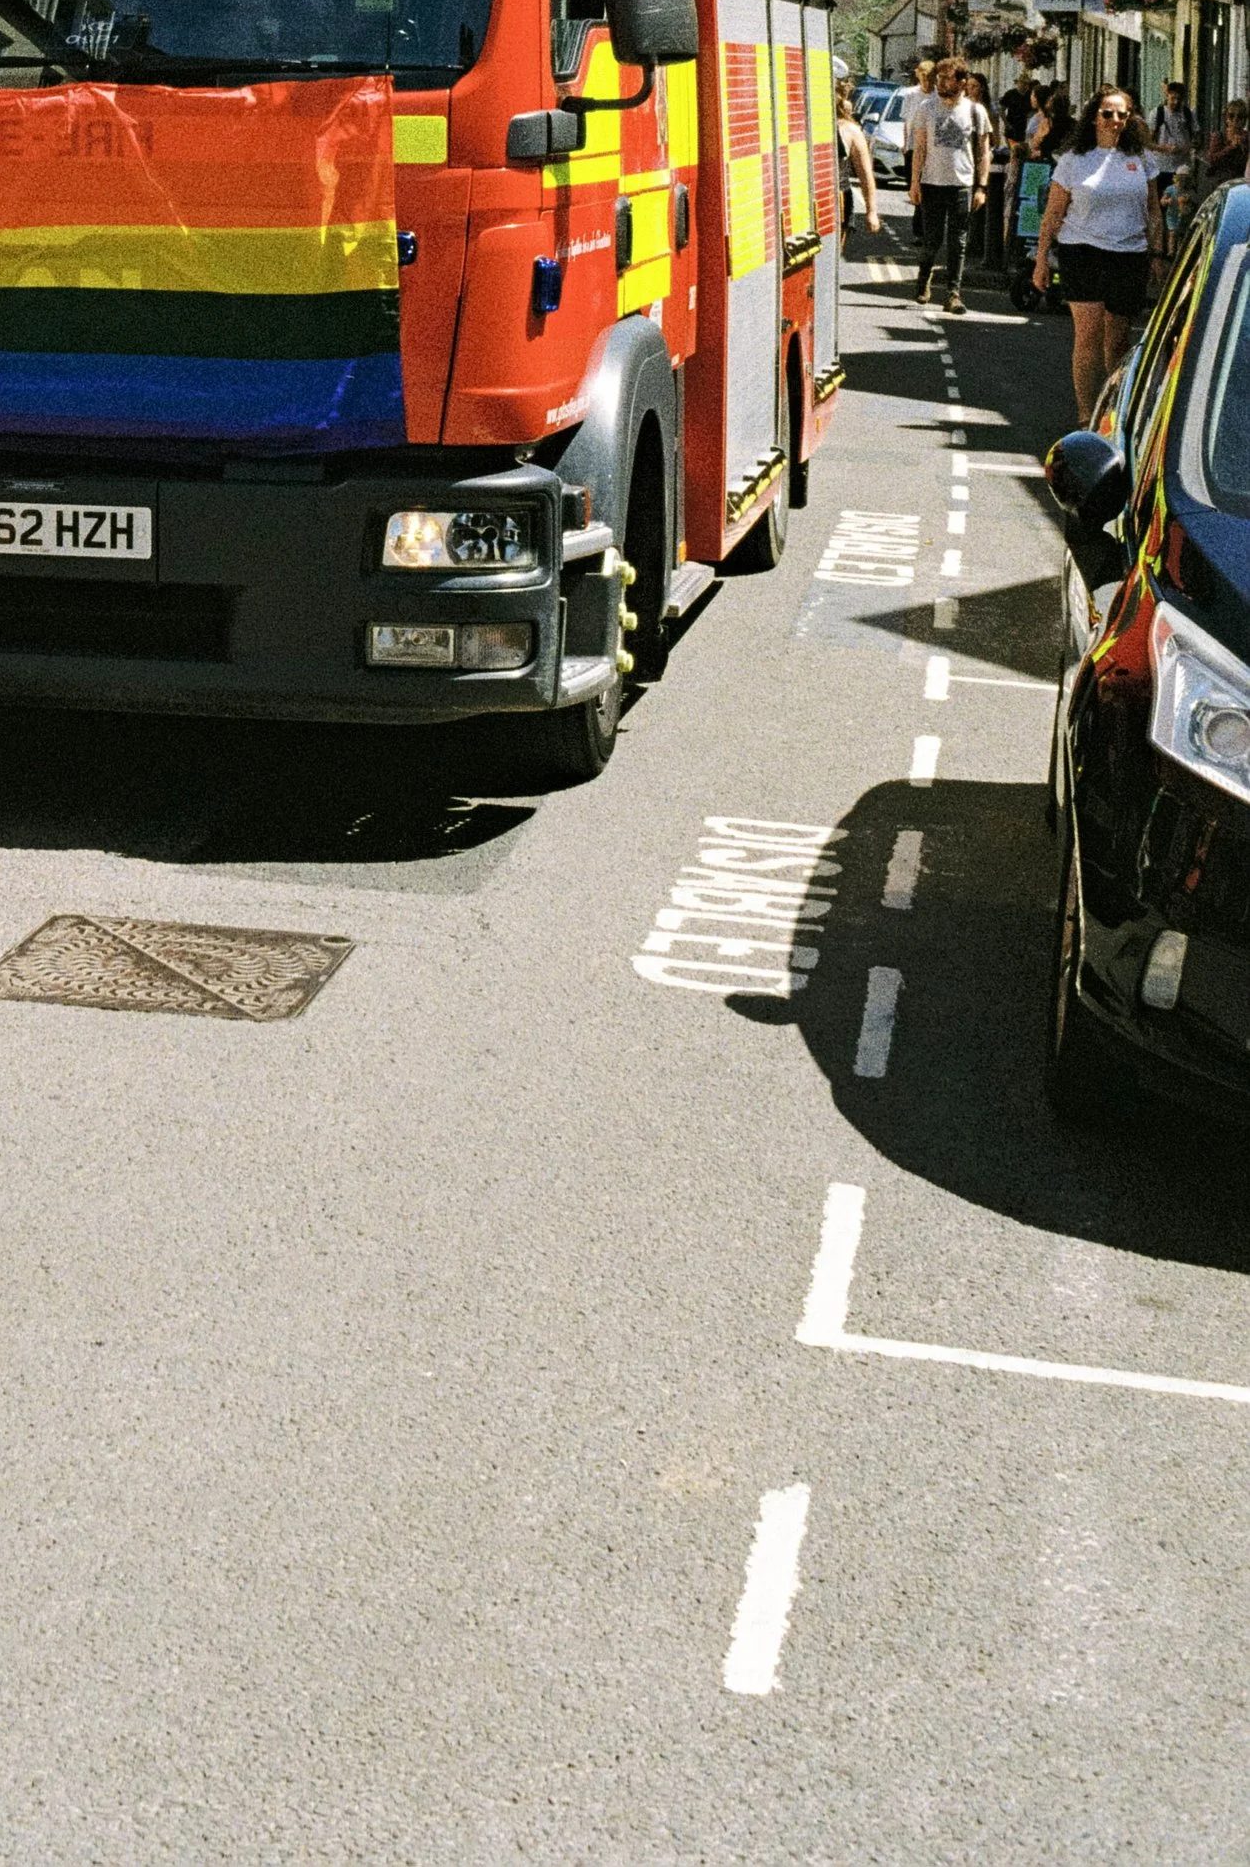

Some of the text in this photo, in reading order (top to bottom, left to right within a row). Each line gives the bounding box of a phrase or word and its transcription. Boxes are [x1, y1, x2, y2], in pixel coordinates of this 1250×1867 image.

[56, 510, 134, 550] HZH
[813, 510, 921, 587] DISABLED
[630, 815, 851, 1000] DISABLED
